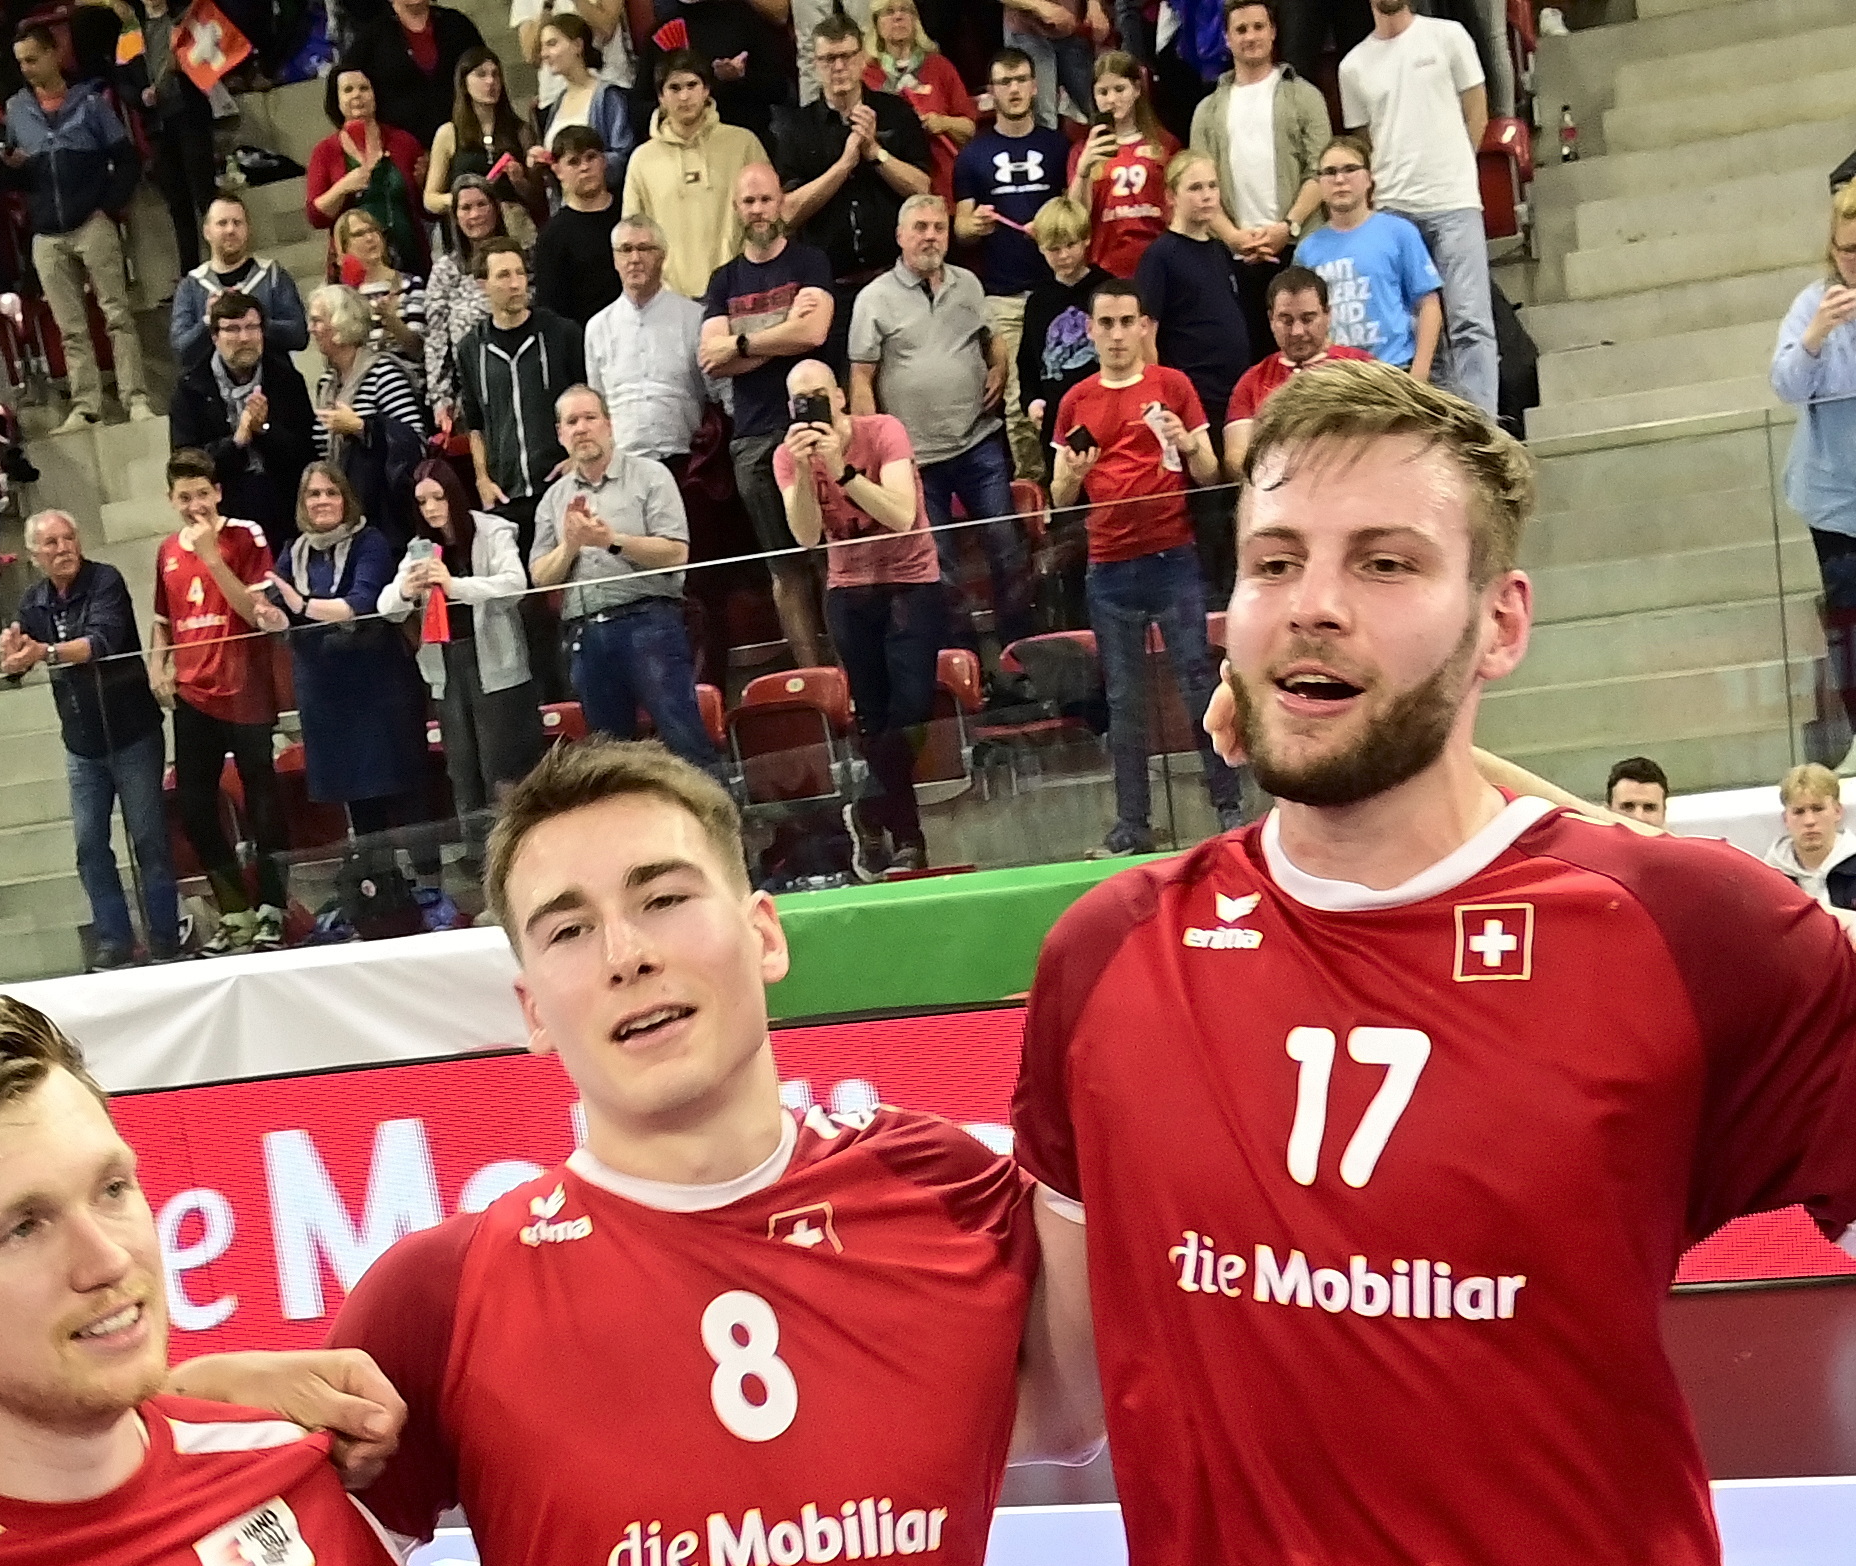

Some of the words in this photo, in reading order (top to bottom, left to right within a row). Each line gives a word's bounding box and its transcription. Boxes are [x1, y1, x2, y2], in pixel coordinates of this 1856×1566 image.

[1110, 164, 1147, 197] 29
[1327, 275, 1372, 302] ERZ
[1328, 299, 1367, 325] ND
[1285, 1026, 1432, 1188] 17
[1168, 1230, 1247, 1298] die
[1252, 1243, 1527, 1320] Mobiliar
[700, 1289, 798, 1442] 8
